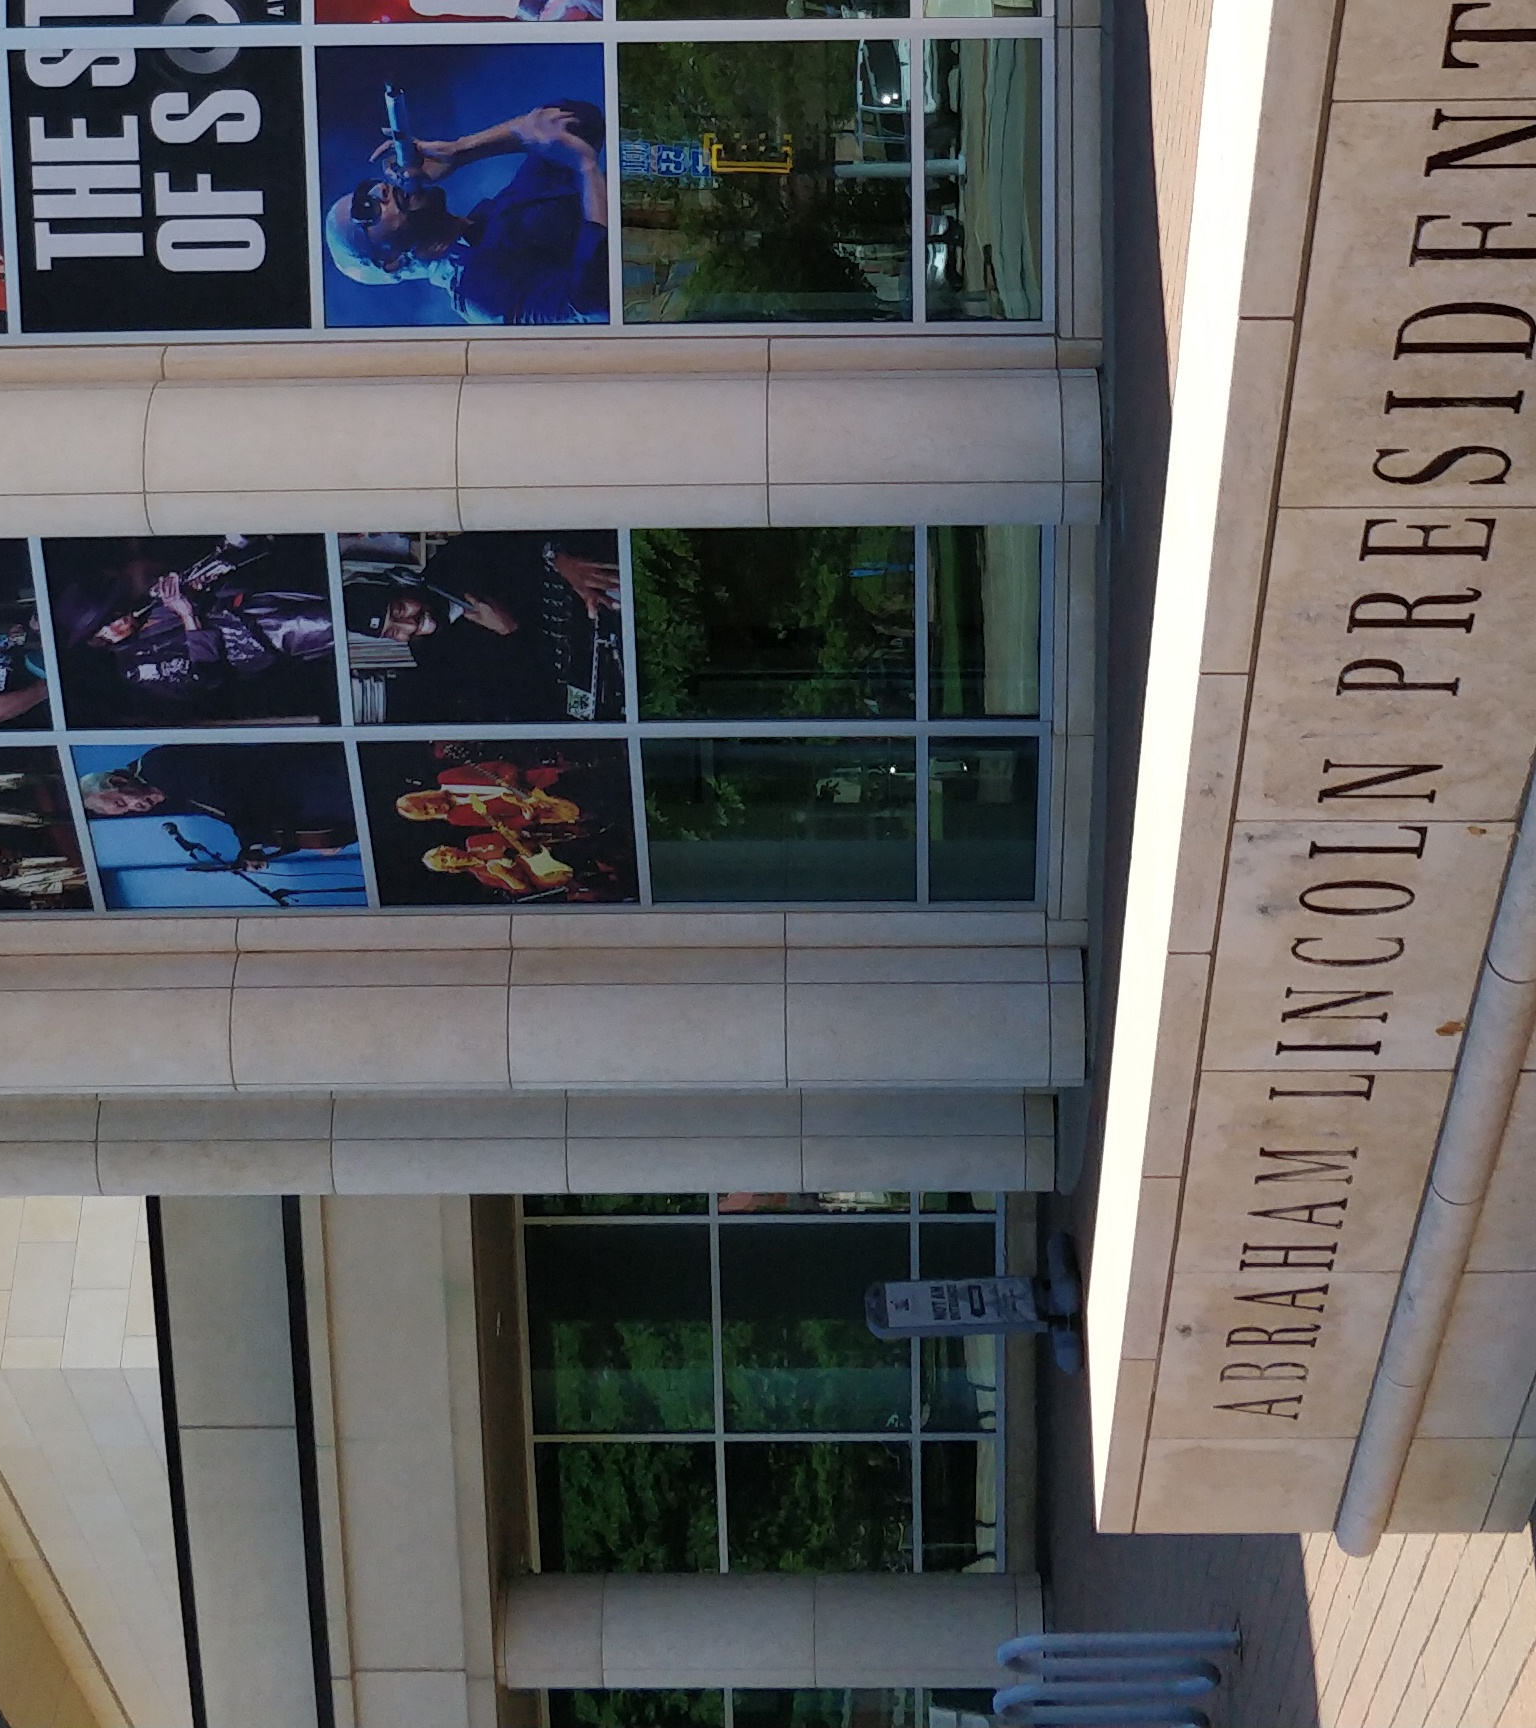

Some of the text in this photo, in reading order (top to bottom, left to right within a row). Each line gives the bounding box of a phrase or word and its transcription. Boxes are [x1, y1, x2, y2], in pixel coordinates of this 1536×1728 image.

[267, 5, 285, 16] A
[29, 114, 145, 271] THE
[153, 172, 267, 273] OF
[1268, 757, 1445, 1102] LINCOLN
[1211, 1145, 1359, 1421] ABRAHAM
